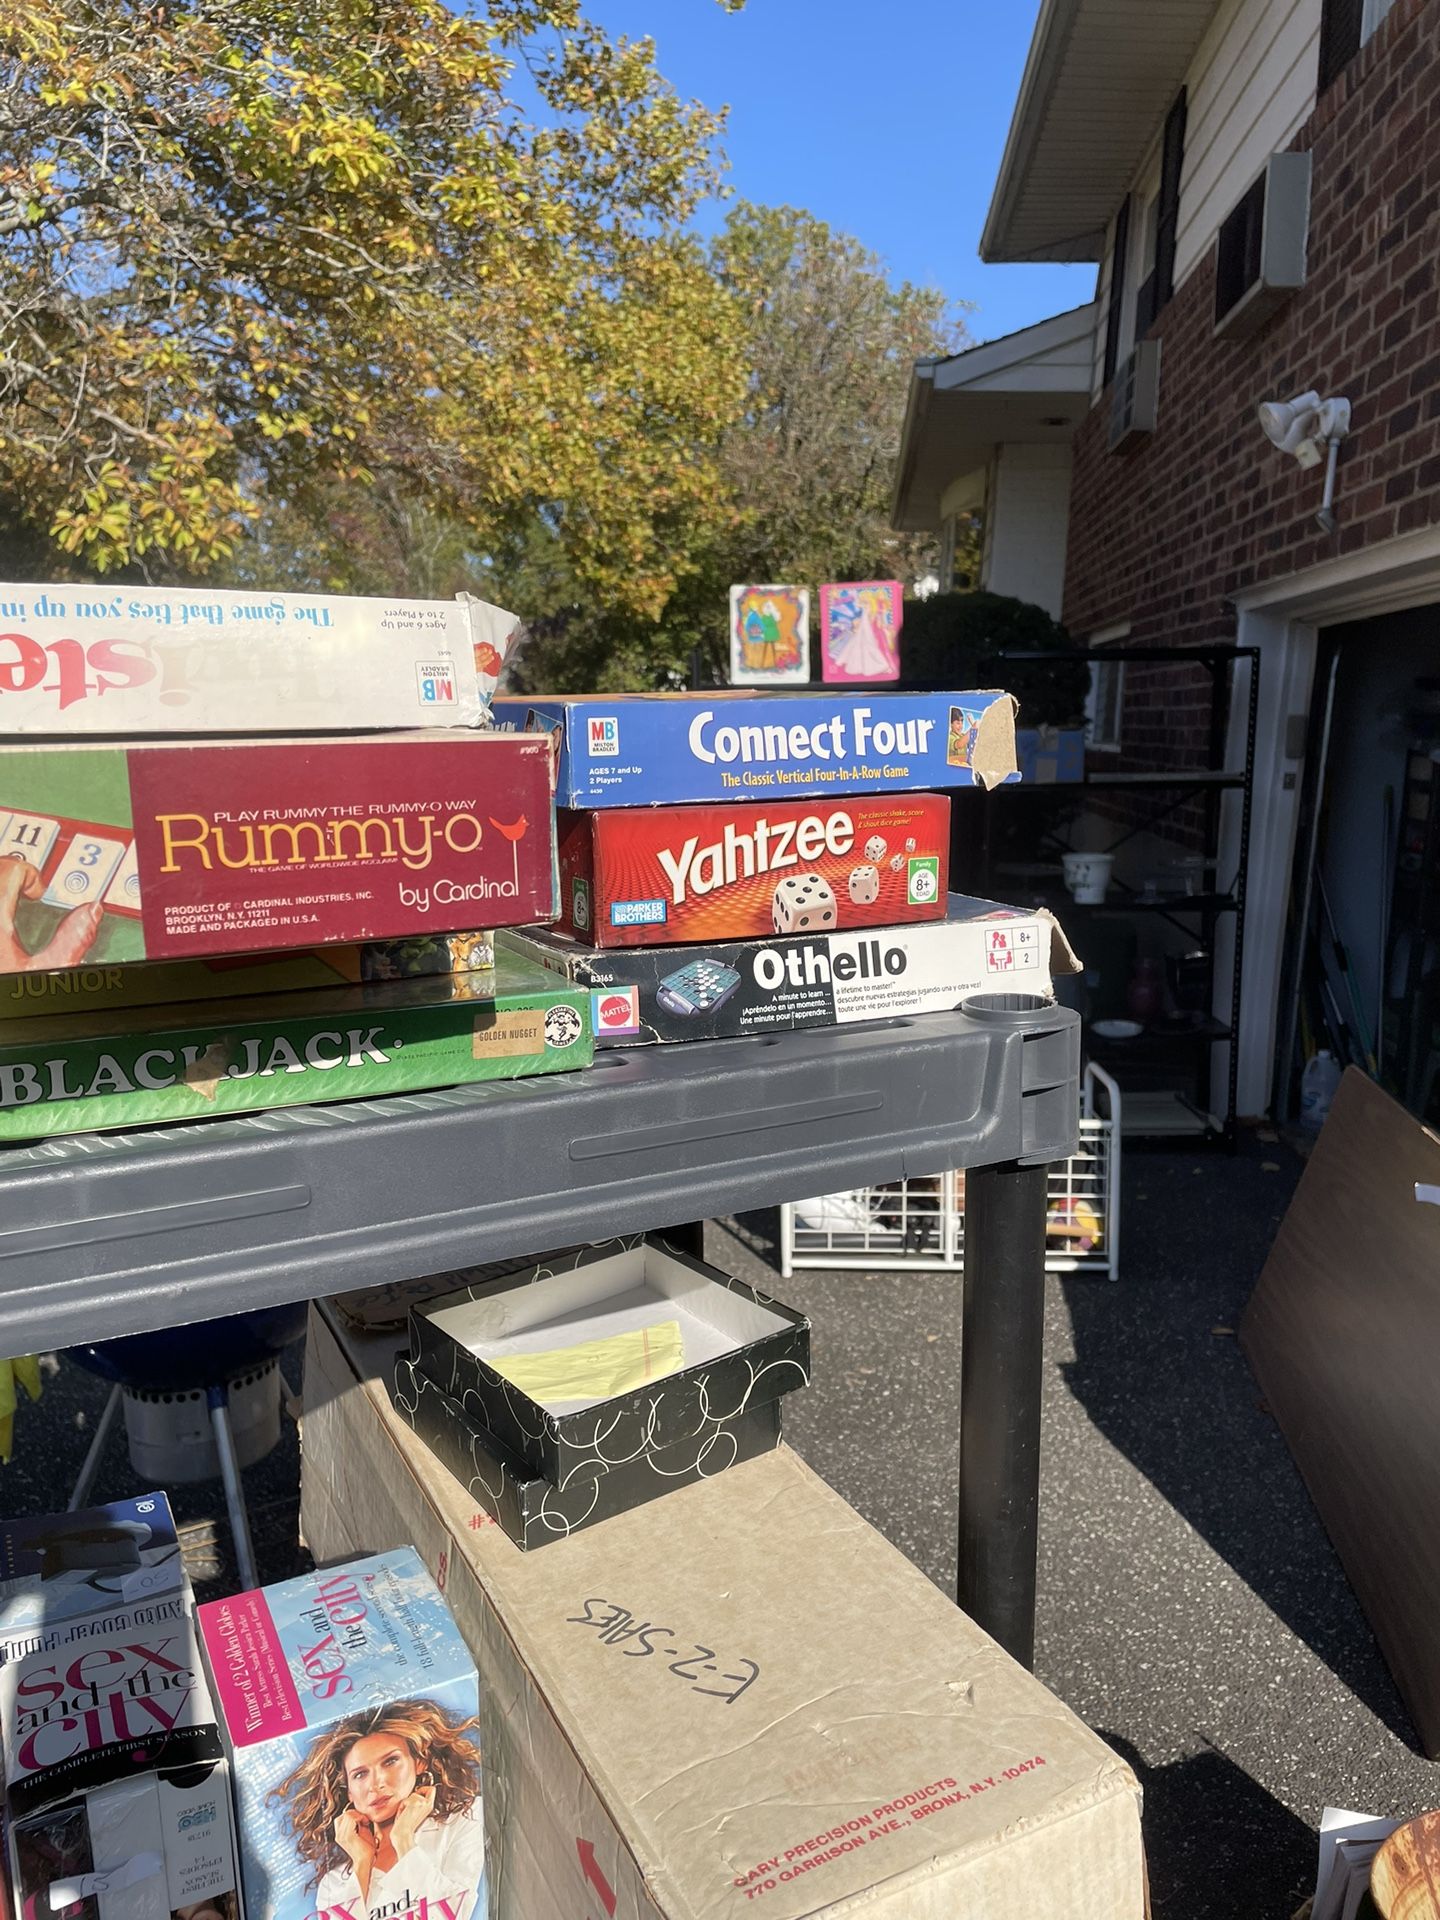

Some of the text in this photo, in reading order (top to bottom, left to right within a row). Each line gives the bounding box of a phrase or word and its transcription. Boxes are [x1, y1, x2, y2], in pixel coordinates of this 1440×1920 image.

[0, 594, 334, 627] The game that ties you up in
[384, 608, 445, 619] 2 to 4 Players
[381, 620, 447, 630] Ages 6 and Up
[422, 679, 453, 701] MB
[591, 721, 616, 740] MB
[688, 707, 934, 764] Connect Four
[589, 767, 609, 775] AGES
[632, 766, 642, 775] Up
[596, 777, 622, 785] Players
[721, 764, 909, 788] The Classic Vertical Four-In-A-Row Game
[214, 799, 477, 823] PLAY RUMMY THE RUMMY-O WAY
[858, 812, 868, 820] The
[869, 811, 888, 819] classic
[11, 823, 43, 847] 11
[79, 843, 102, 866] 3
[656, 811, 855, 905] Yahtzee
[268, 865, 294, 873] GAME
[308, 860, 360, 870] WORLDWIDE
[916, 861, 931, 870] Family
[399, 870, 519, 912] by Cardinal
[916, 879, 930, 890] 8+
[164, 891, 374, 916] PRODUCT OF CARDINAL INDUSTRIES, INC.
[627, 902, 663, 912] PARKER
[165, 909, 270, 925] BROOKLYN, N.Y. 11211
[166, 914, 320, 935] MADE AND PACKAGED IN U.S.A.
[614, 912, 664, 922] BROTHERS
[1020, 932, 1031, 943] 8+
[753, 940, 907, 990] Othello
[1024, 953, 1029, 963] 2
[11, 967, 124, 999] JUNIOR
[841, 984, 871, 994] lifetime to
[778, 992, 799, 1002] minute
[800, 992, 807, 1000] to
[808, 990, 824, 998] learn
[836, 995, 865, 1004] descubre
[865, 993, 886, 1001] nuevas
[886, 989, 917, 1000] estrategias
[917, 986, 941, 997] jugando
[600, 1004, 631, 1020] MATTEL
[838, 1005, 855, 1013] toute
[868, 1002, 876, 1010] vie
[877, 1001, 891, 1010] pour
[740, 1013, 790, 1024] Une minute pour
[480, 1028, 537, 1042] GOLDEN NUGGET
[227, 1027, 392, 1079] JACK
[135, 1599, 183, 1625] Auto
[65, 1614, 131, 1644] Cover
[239, 1614, 249, 1634] Parker
[299, 1607, 368, 1649] and the
[216, 1605, 263, 1733] Winner of 2 Golden Globes
[297, 1632, 354, 1700] sex
[395, 1656, 408, 1666] the
[419, 1658, 434, 1668] 18
[17, 1636, 193, 1717] sex
[266, 1654, 292, 1721] Best Television Series
[17, 1669, 197, 1735] and the
[263, 1693, 273, 1708] Best
[18, 1686, 198, 1771] city
[21, 1729, 208, 1790] THE COMPLETE FIRST SEASON
[178, 1806, 216, 1831] HBO
[743, 1879, 777, 1900] 770
[778, 1834, 866, 1882] GARRISON
[910, 1791, 971, 1822] BRONX,
[969, 1775, 1002, 1795] N.Y.
[1002, 1756, 1047, 1781] 10474
[784, 1815, 870, 1862] PRECISION
[873, 1777, 958, 1821] PRODUCTS
[179, 1856, 222, 1876] EPISODES
[370, 1889, 411, 1920] and
